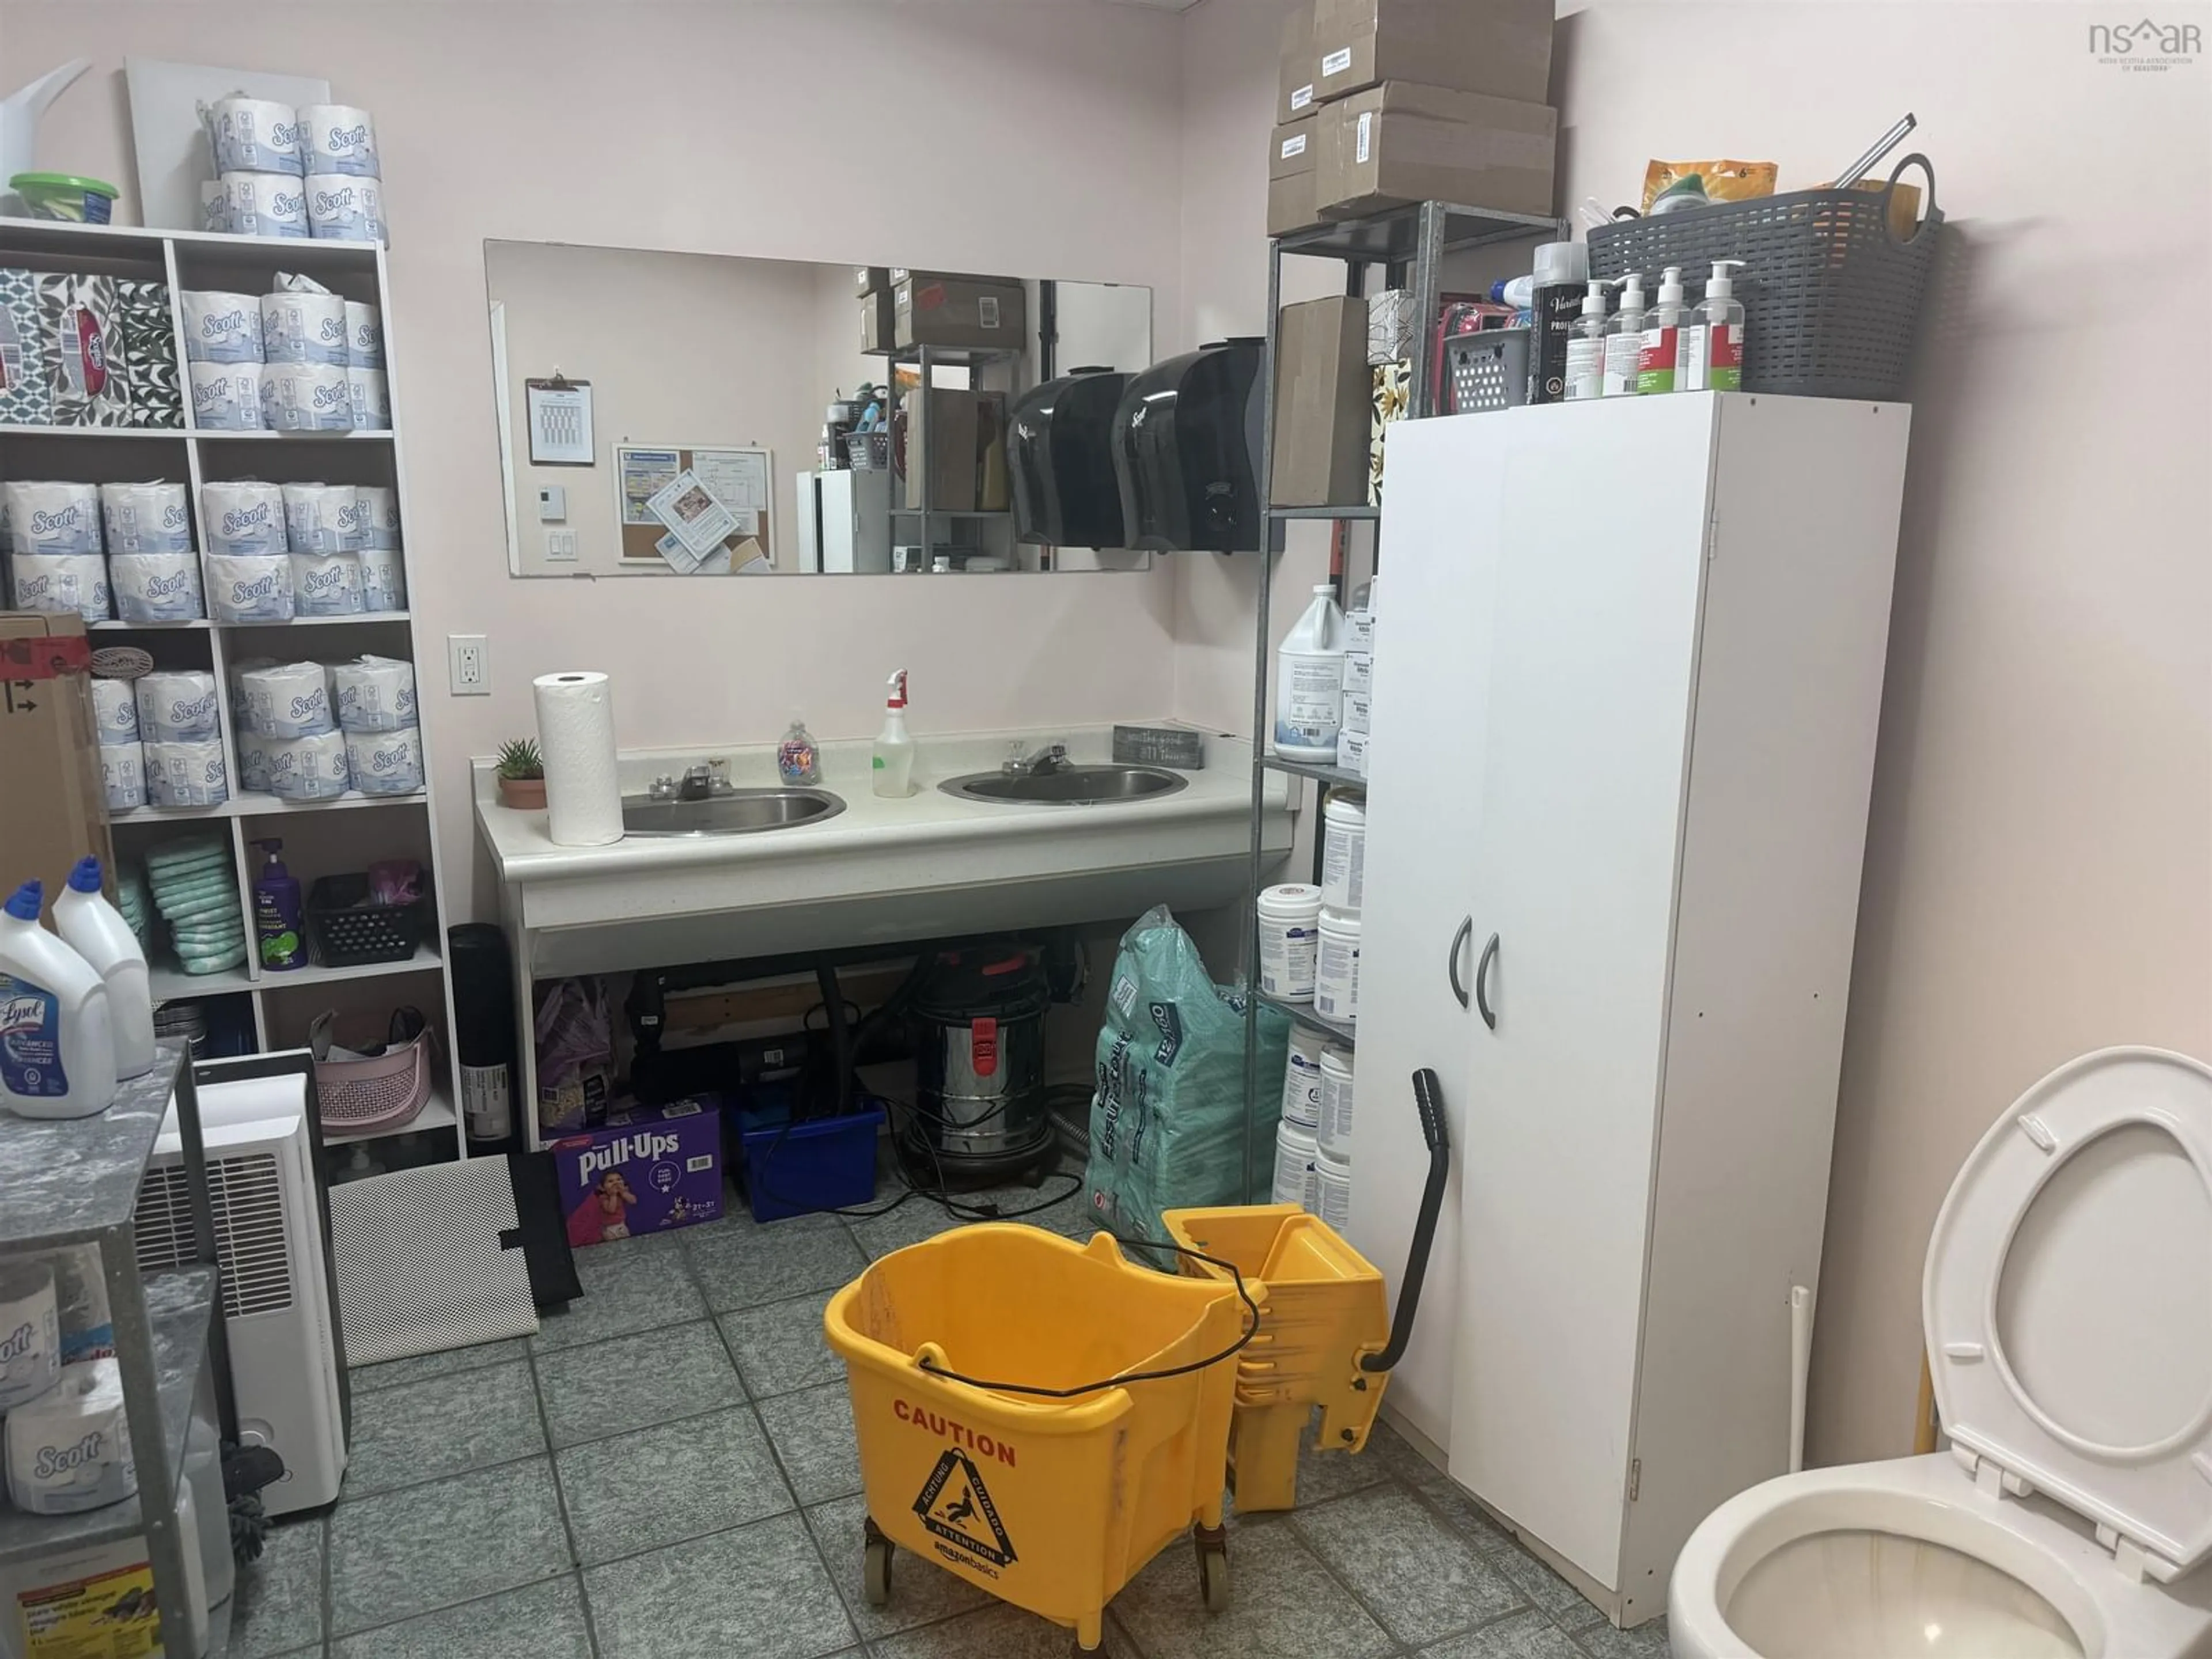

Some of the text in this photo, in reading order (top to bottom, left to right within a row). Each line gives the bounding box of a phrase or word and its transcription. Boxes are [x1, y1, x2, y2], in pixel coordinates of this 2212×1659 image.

[329, 126, 365, 150] Scott
[316, 187, 353, 214] Scott
[202, 310, 243, 337] Scott
[194, 377, 228, 406] Scott
[31, 506, 77, 534] Scott
[223, 502, 268, 534] Scott
[18, 575, 49, 600] Scott
[147, 570, 185, 598] Scott
[232, 576, 273, 603] Scott
[305, 565, 341, 593] Scott
[290, 688, 323, 719] Scott
[373, 745, 407, 772] Scott
[3, 1001, 43, 1025] Lysol
[893, 1399, 1016, 1467] CAUTION
[35, 1432, 102, 1479] Scott
[923, 1462, 949, 1505] ACHTUNG
[972, 1476, 1003, 1537] CUIDADO
[935, 1524, 995, 1560] ATTENTION
[934, 1541, 999, 1580] amazonbasics
